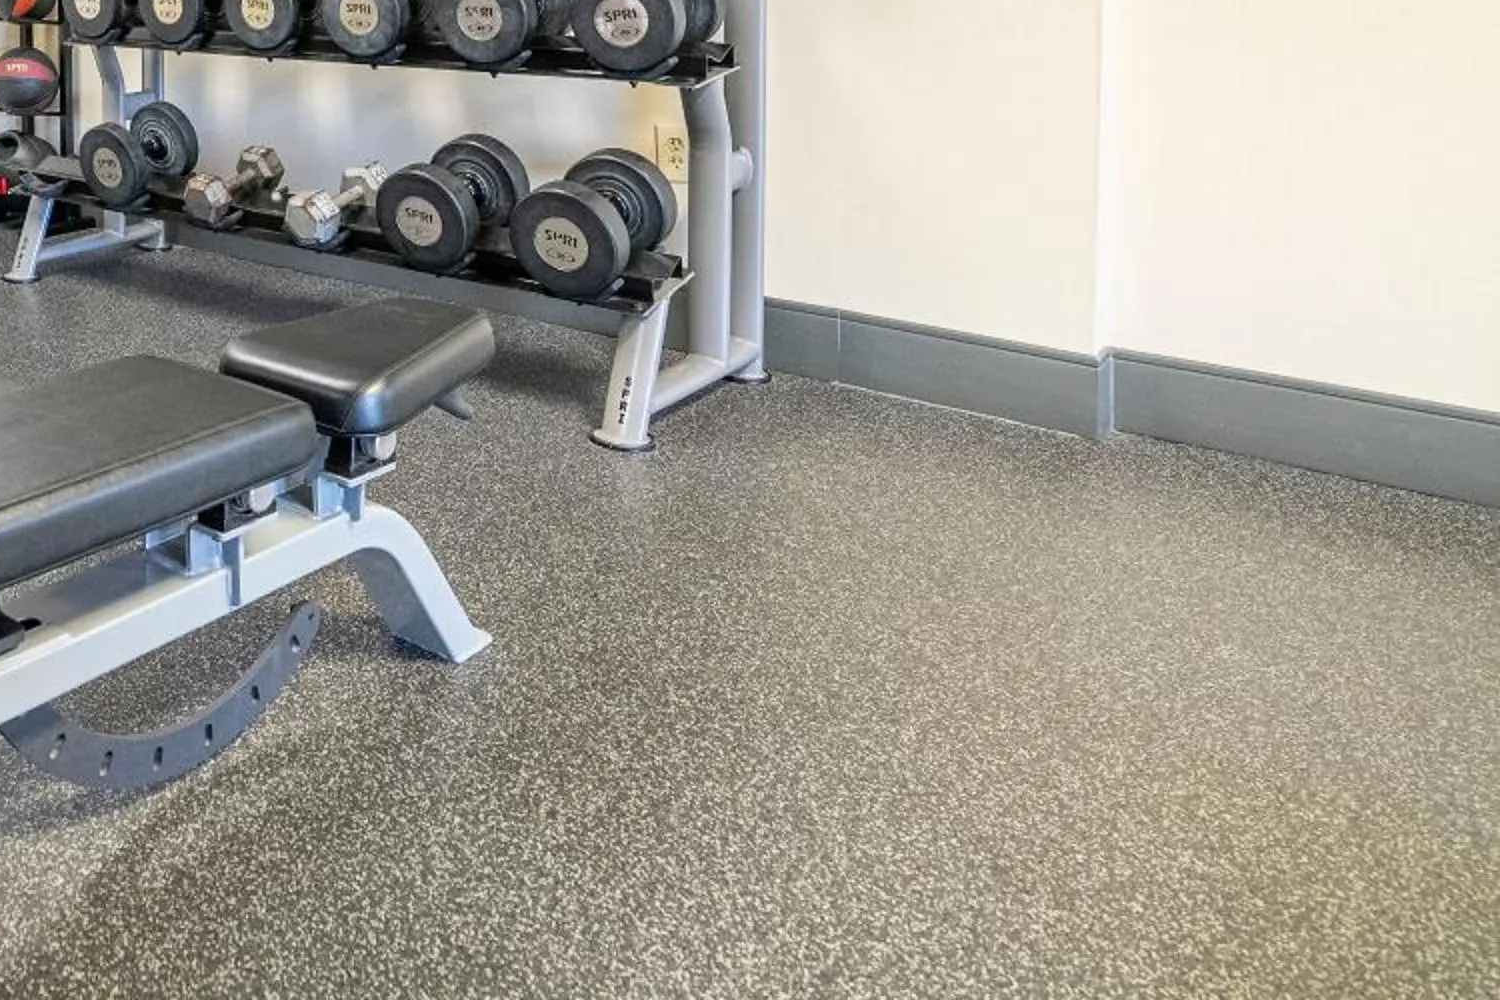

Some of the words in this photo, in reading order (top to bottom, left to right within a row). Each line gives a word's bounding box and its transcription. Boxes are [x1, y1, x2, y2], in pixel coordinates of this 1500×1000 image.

[345, 2, 371, 16] SPRI
[464, 6, 494, 18] SPRI
[603, 7, 637, 23] SPRI
[405, 206, 433, 225] SPRI
[544, 228, 579, 249] SPRI
[618, 375, 632, 425] SPRI
